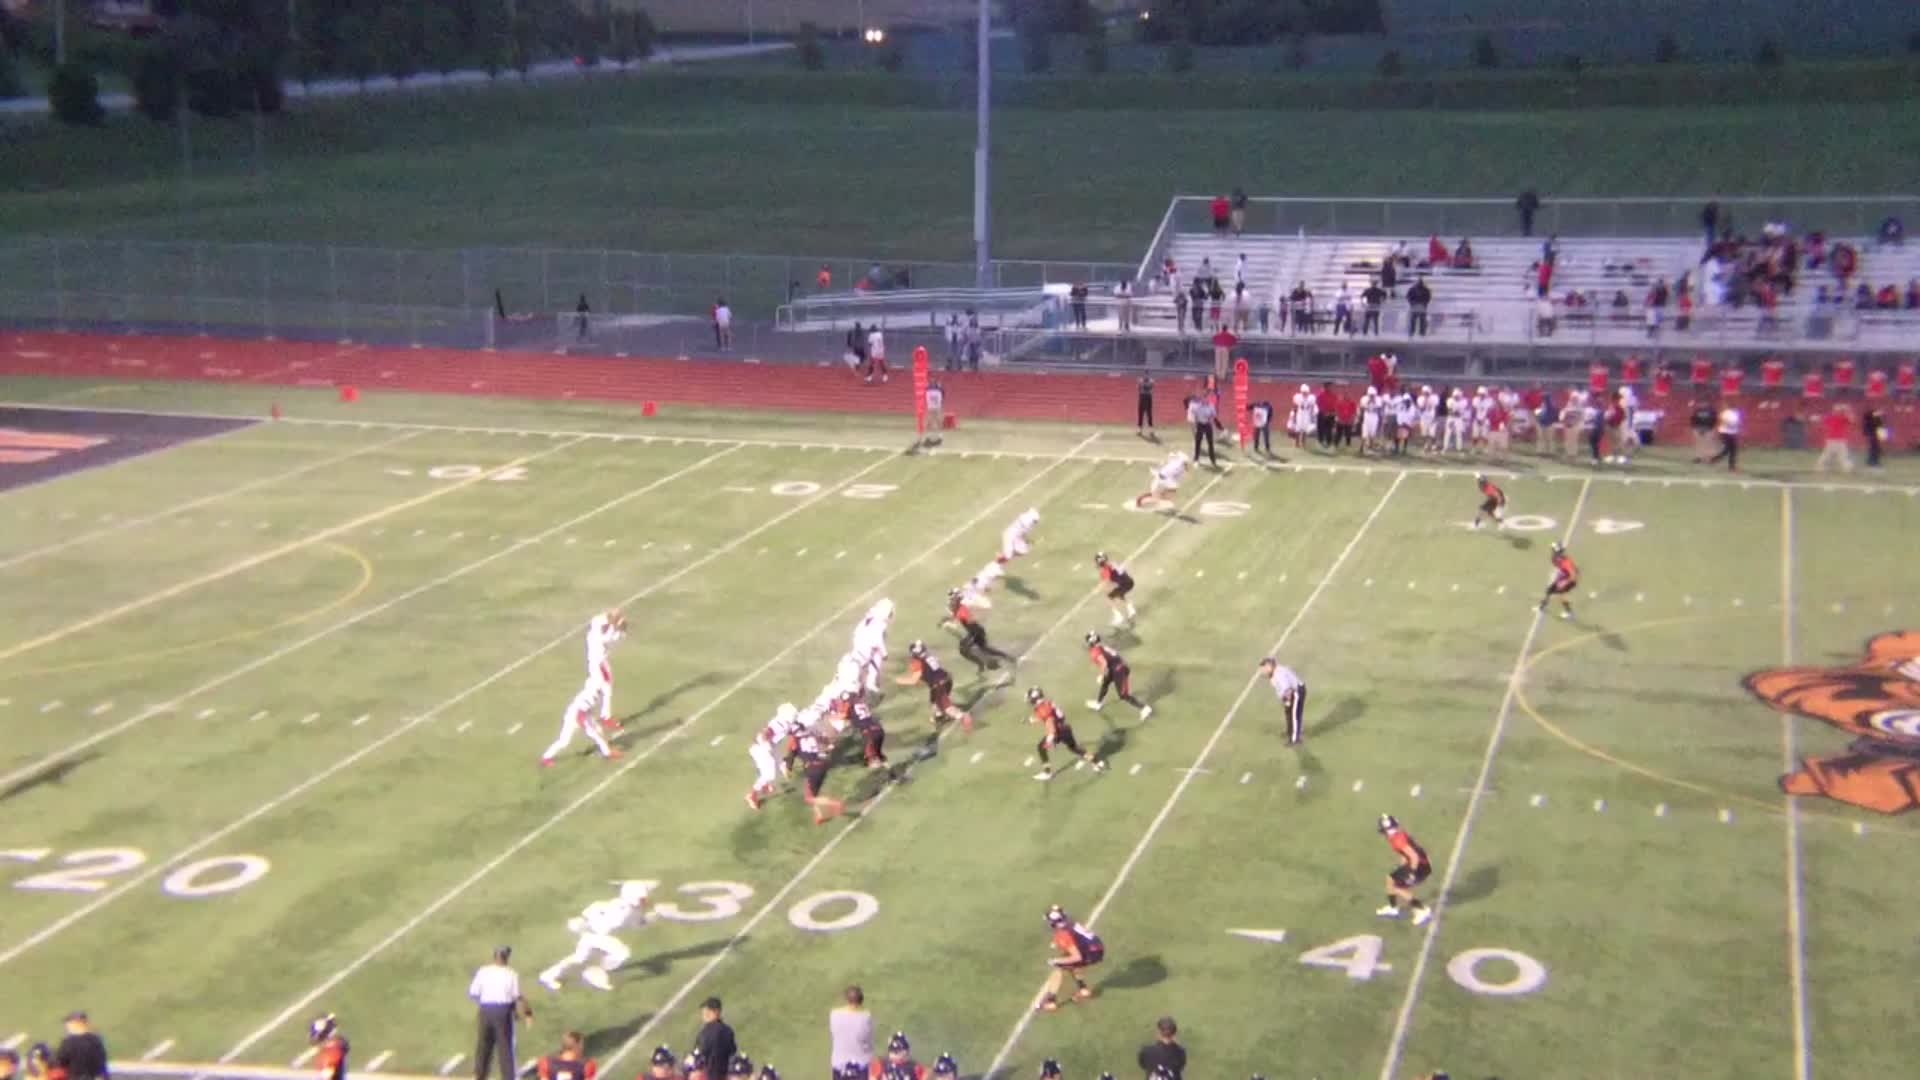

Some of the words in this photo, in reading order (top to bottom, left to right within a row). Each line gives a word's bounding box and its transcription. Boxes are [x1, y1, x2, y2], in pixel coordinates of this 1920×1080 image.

[1503, 514, 1646, 535] 40
[12, 847, 271, 898] 20
[653, 880, 880, 932] 30
[1297, 933, 1549, 996] 40
